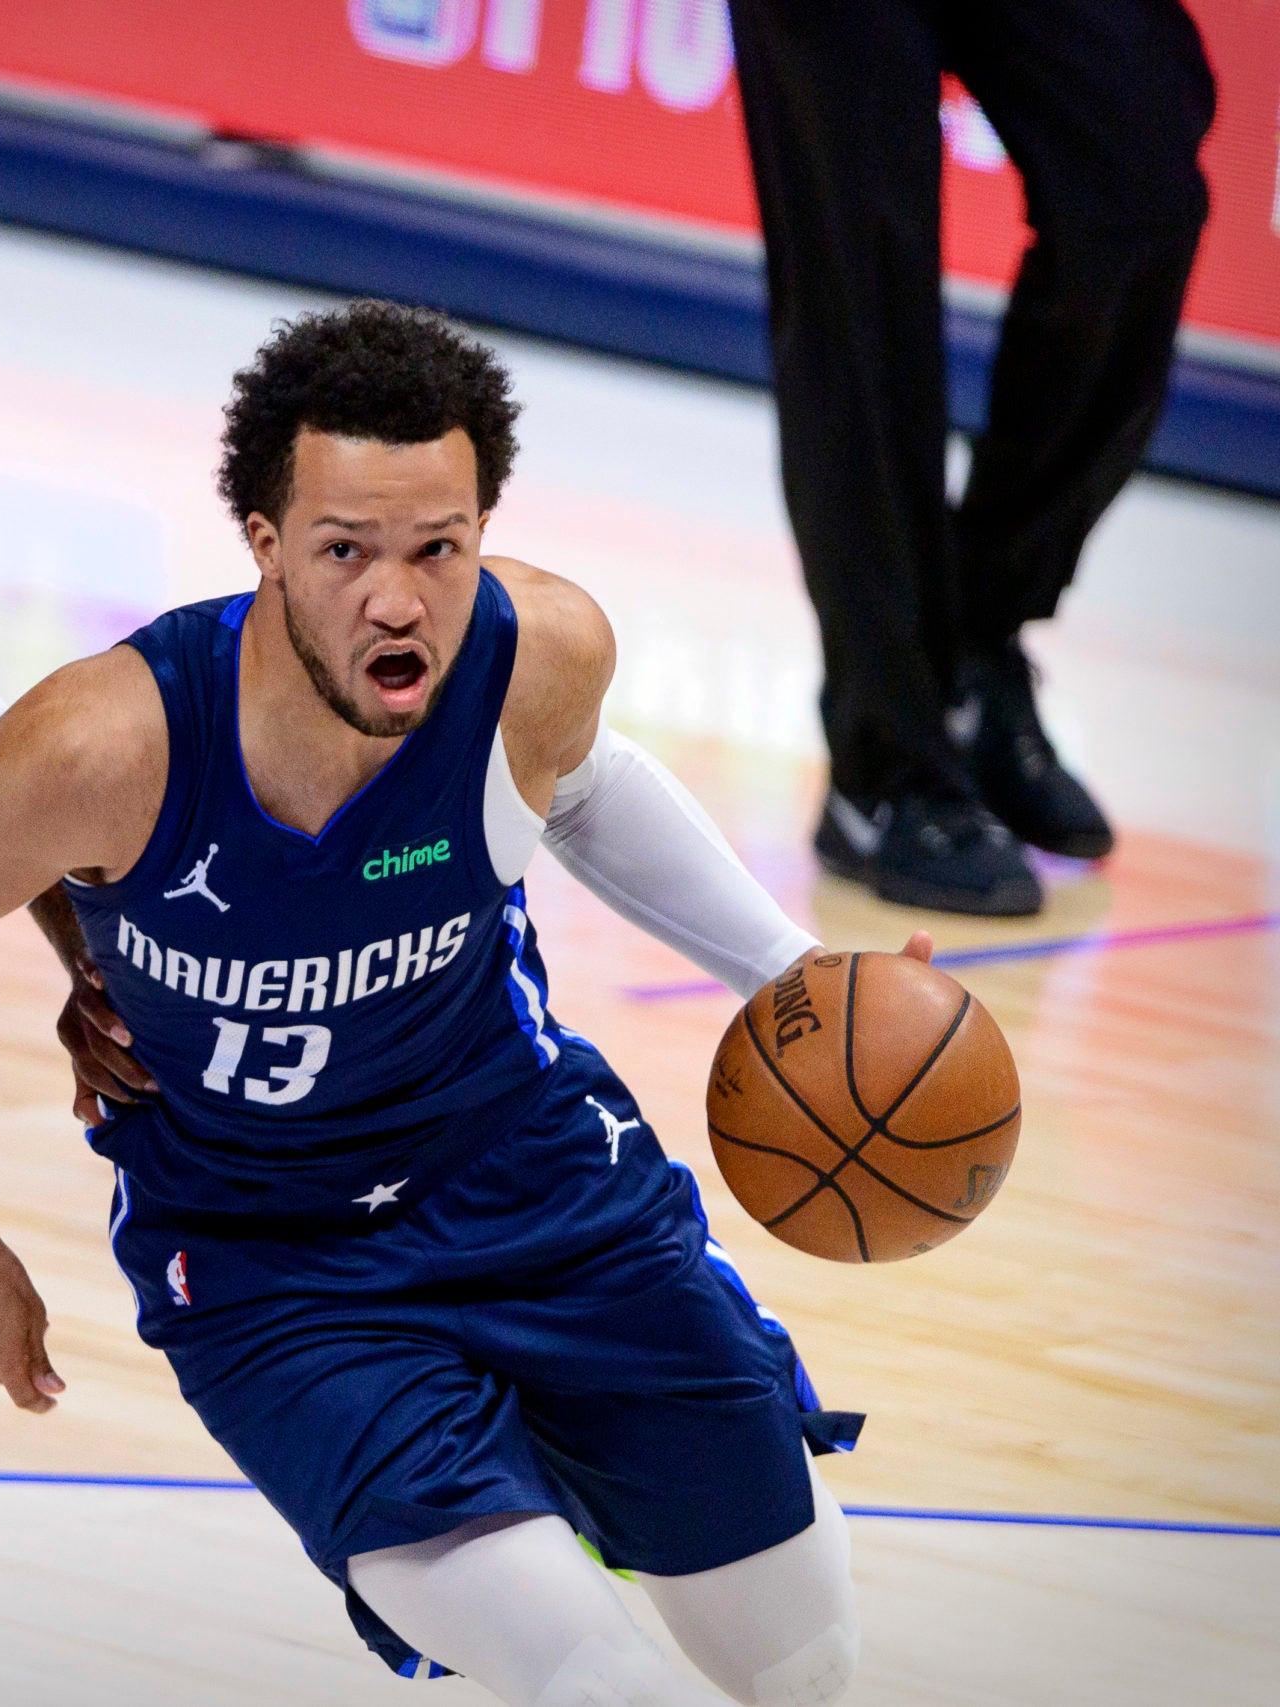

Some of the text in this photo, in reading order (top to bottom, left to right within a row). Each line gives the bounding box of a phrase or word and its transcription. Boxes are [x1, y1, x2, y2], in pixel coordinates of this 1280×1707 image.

[362, 838, 451, 881] chime
[117, 912, 472, 1013] MAVERICKS
[202, 1017, 332, 1106] 13
